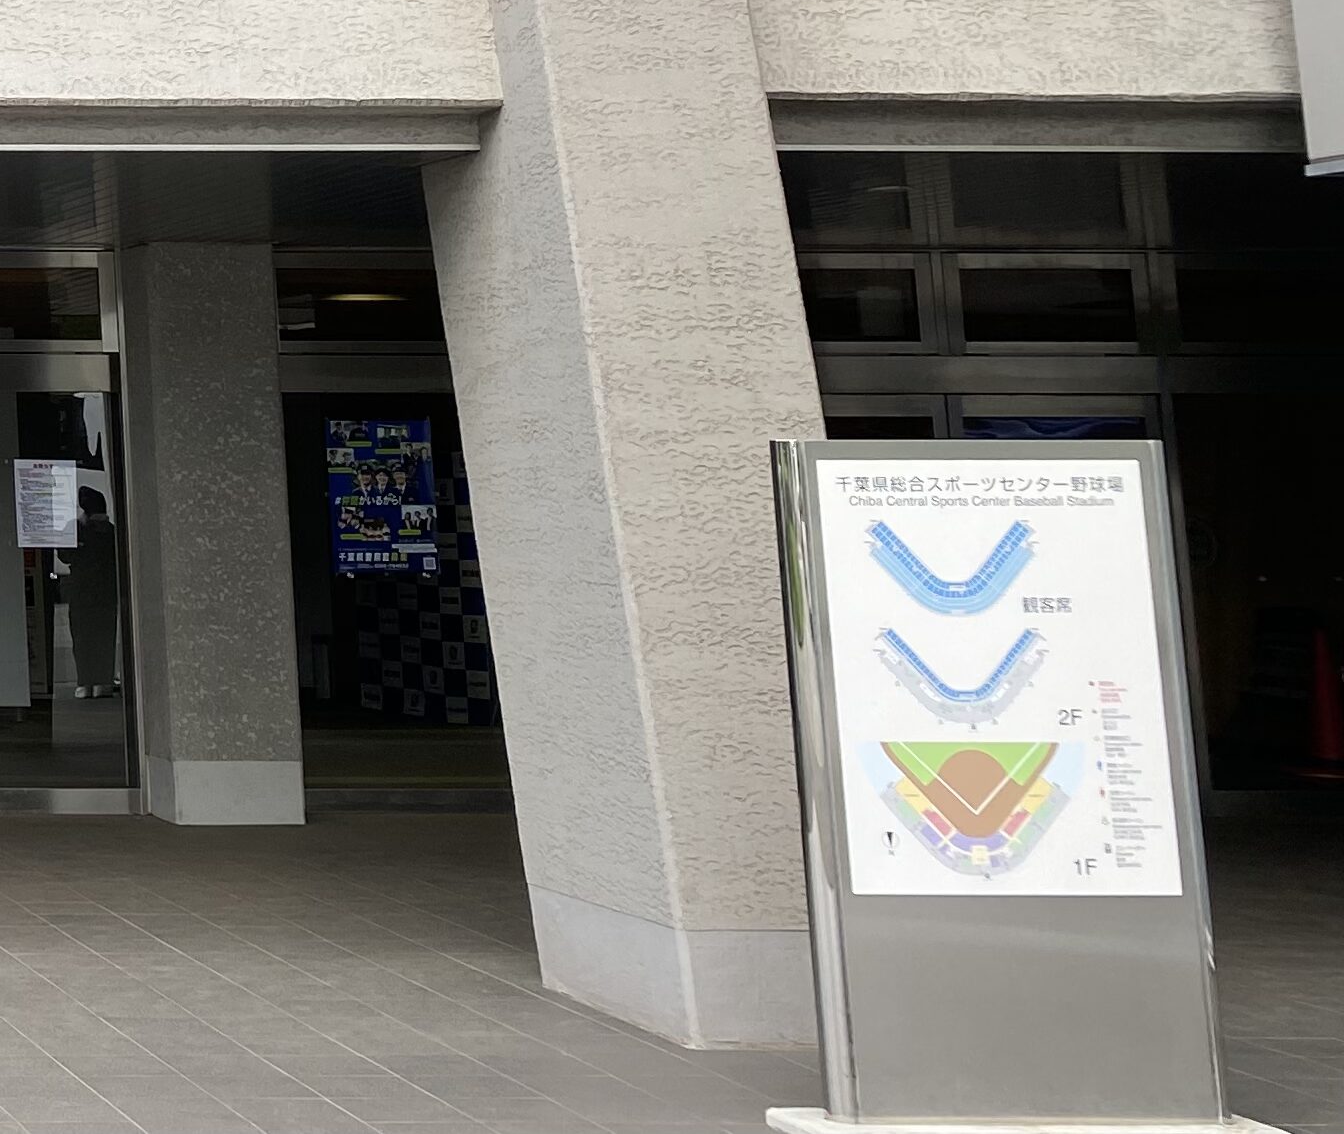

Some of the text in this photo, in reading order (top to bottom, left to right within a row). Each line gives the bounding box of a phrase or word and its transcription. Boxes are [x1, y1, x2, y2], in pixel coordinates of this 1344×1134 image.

[835, 476, 1124, 493] 千葉県総合スポーツセンター野球場
[849, 495, 1115, 509] Chiba Central Sports Center Baseball Stadium
[1022, 597, 1073, 614] 観客席
[1058, 709, 1083, 726] 2F
[1073, 858, 1098, 875] 1F
